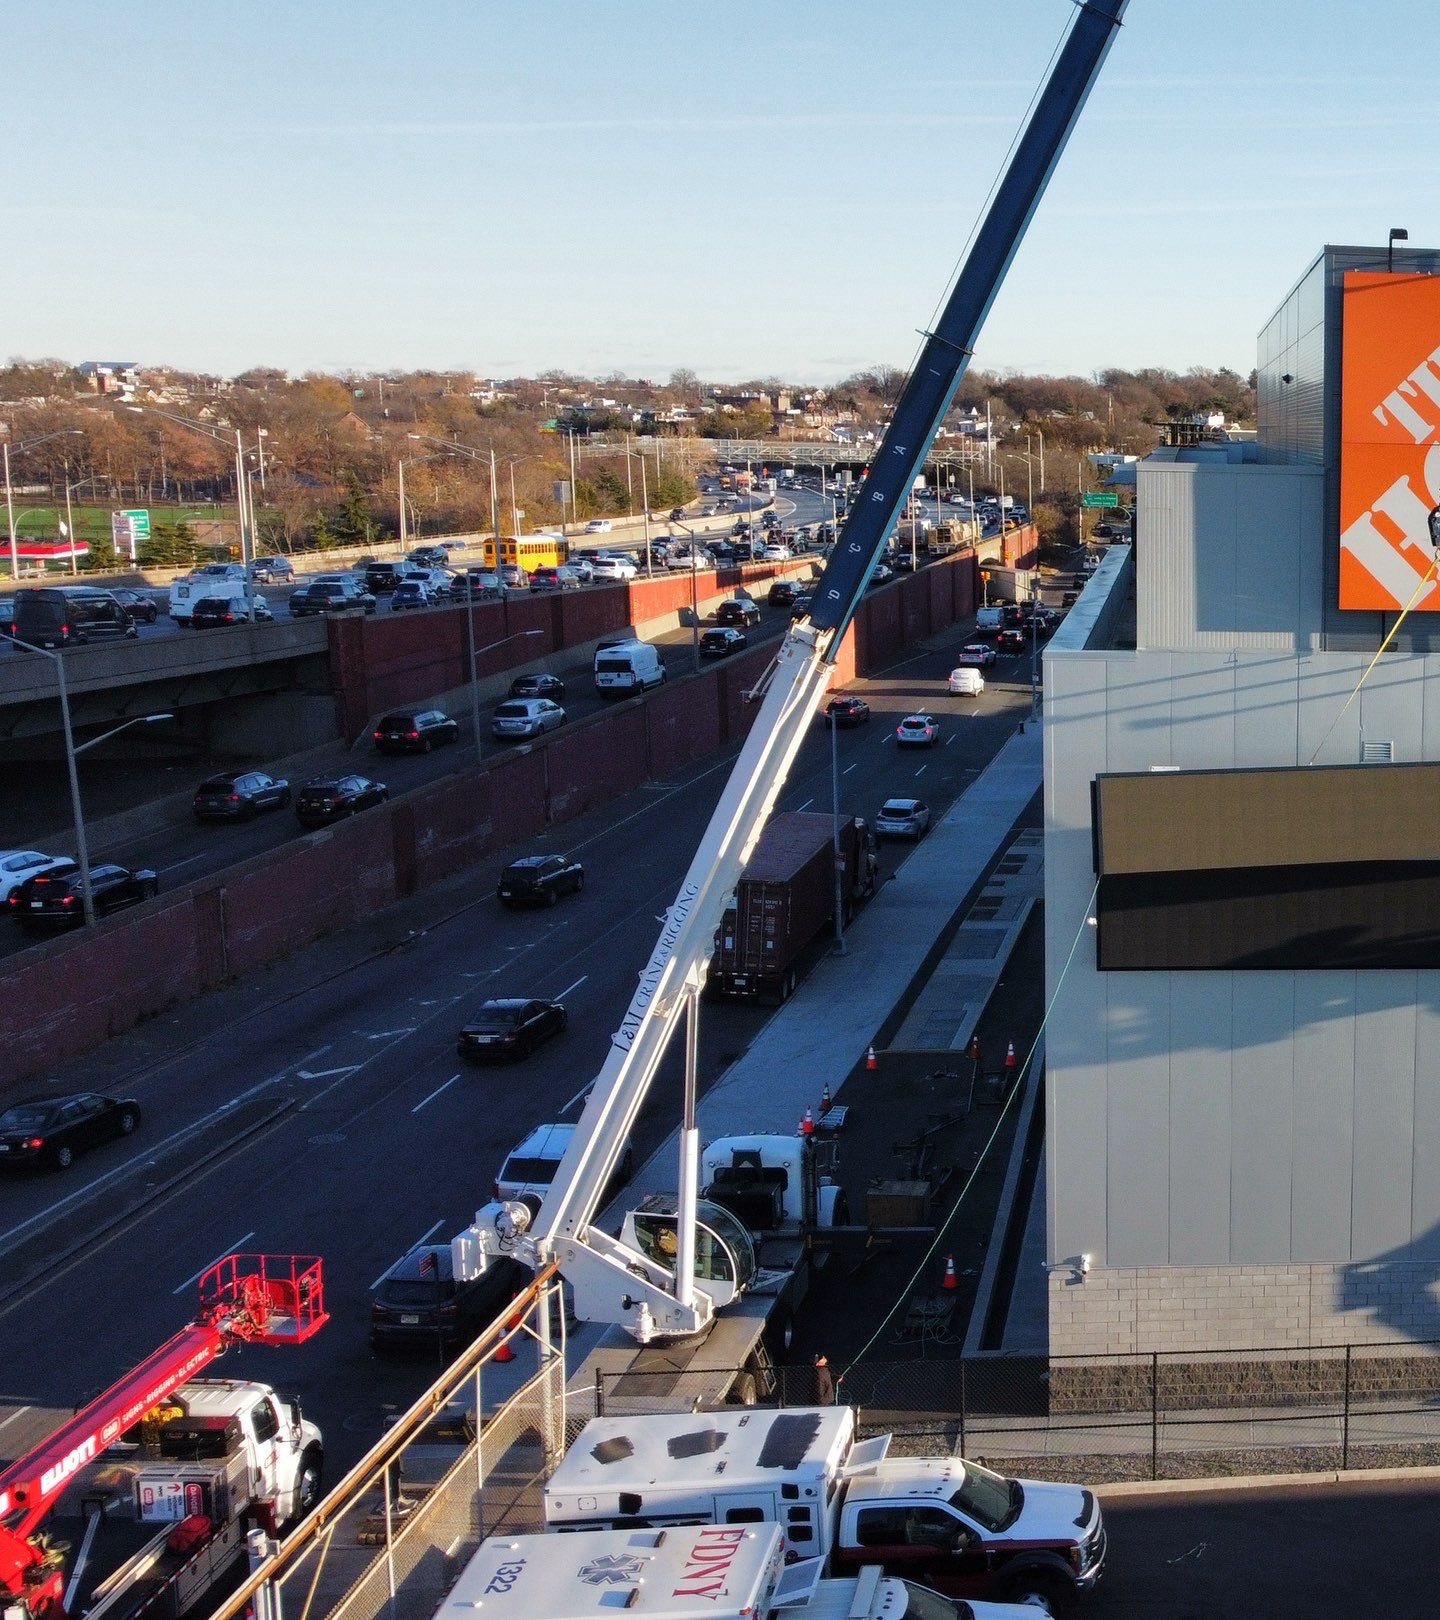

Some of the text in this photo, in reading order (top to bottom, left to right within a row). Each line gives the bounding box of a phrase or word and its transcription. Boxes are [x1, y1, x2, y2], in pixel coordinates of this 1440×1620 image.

[614, 1011, 644, 1052] L&M
[122, 1403, 144, 1423] SIGNS
[179, 1346, 210, 1378] ELECTRIC
[484, 1558, 528, 1595] 1322
[671, 1527, 746, 1601] FDNY
